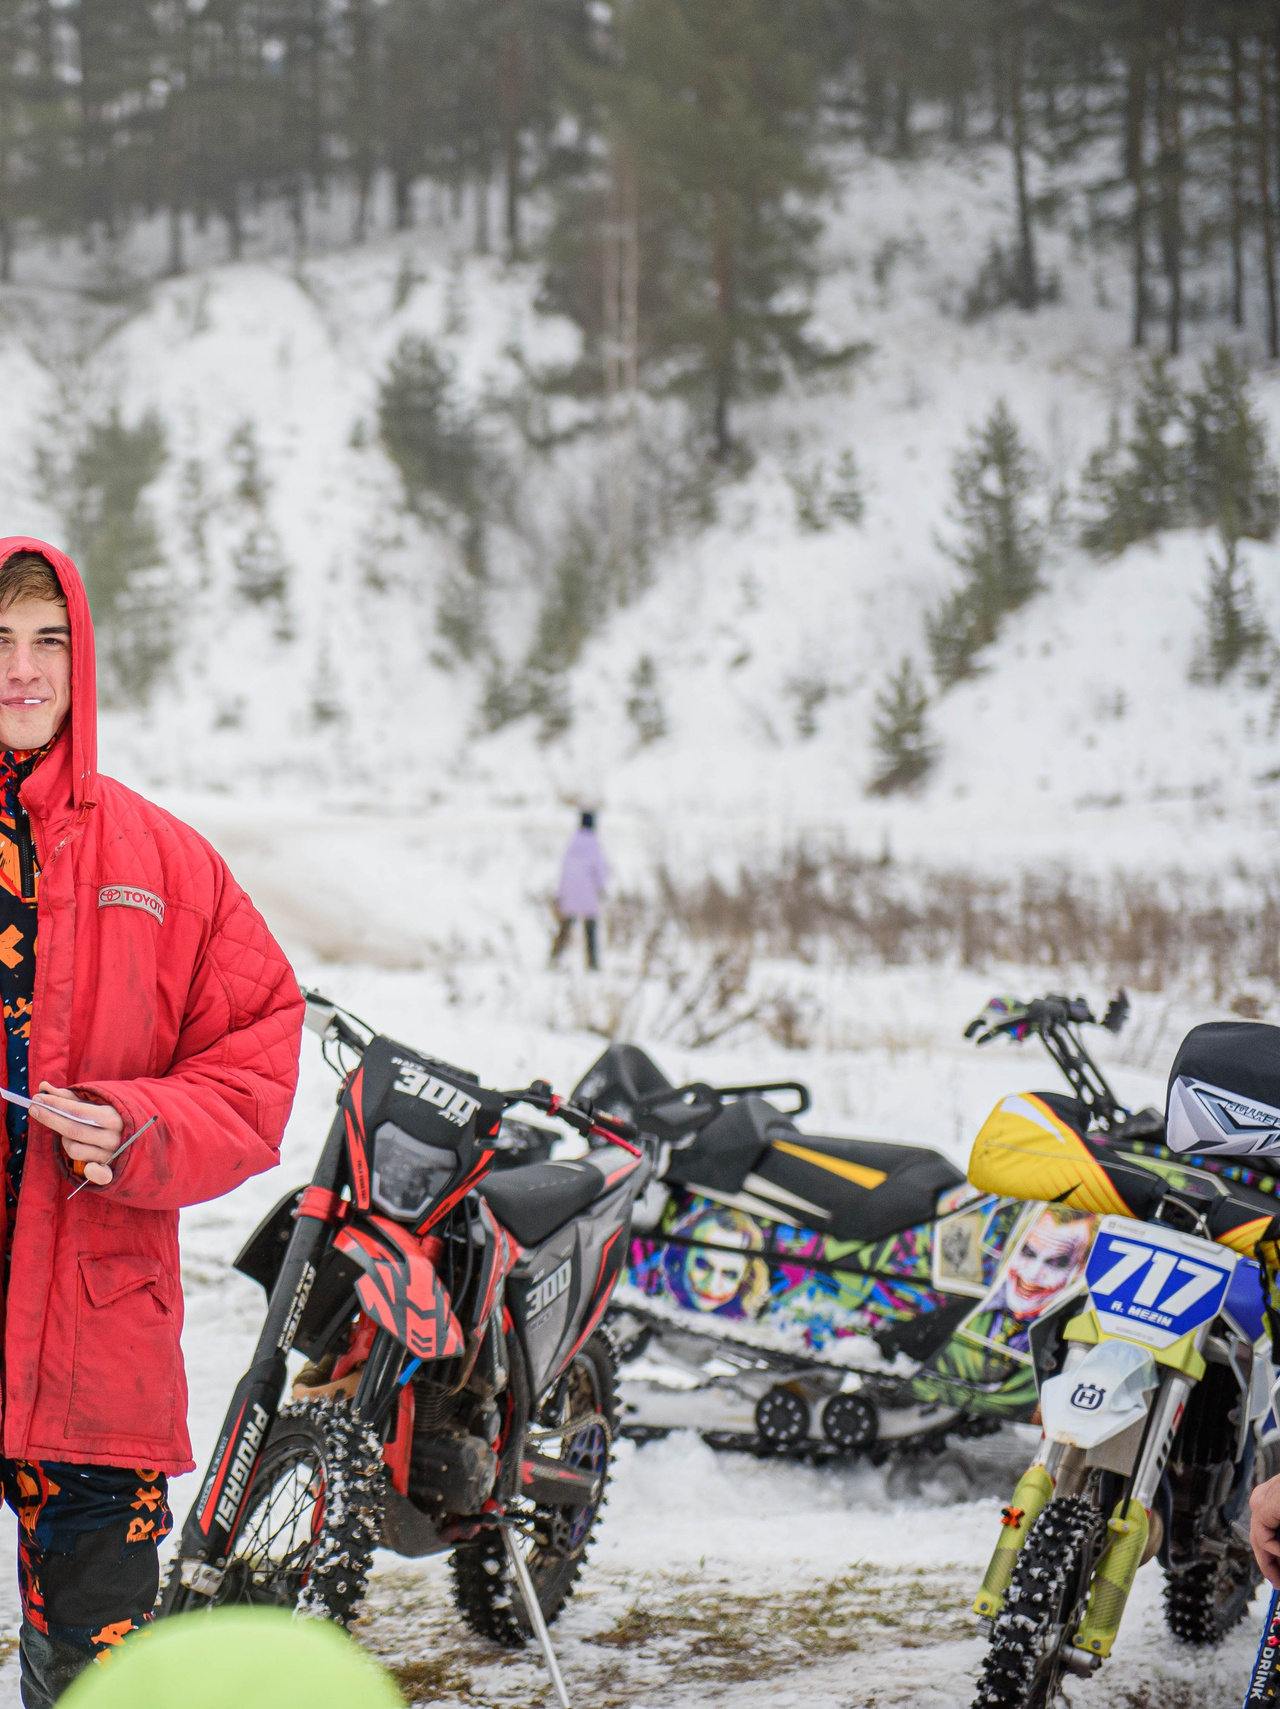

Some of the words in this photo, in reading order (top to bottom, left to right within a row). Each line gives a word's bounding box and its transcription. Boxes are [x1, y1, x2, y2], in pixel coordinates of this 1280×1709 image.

[394, 1066, 482, 1122] 300
[525, 1257, 572, 1321] 300
[1089, 1239, 1224, 1318] 717
[1127, 1304, 1174, 1328] MEZIN
[214, 1402, 270, 1533] PROGASI
[1249, 1646, 1276, 1701] DRINK
